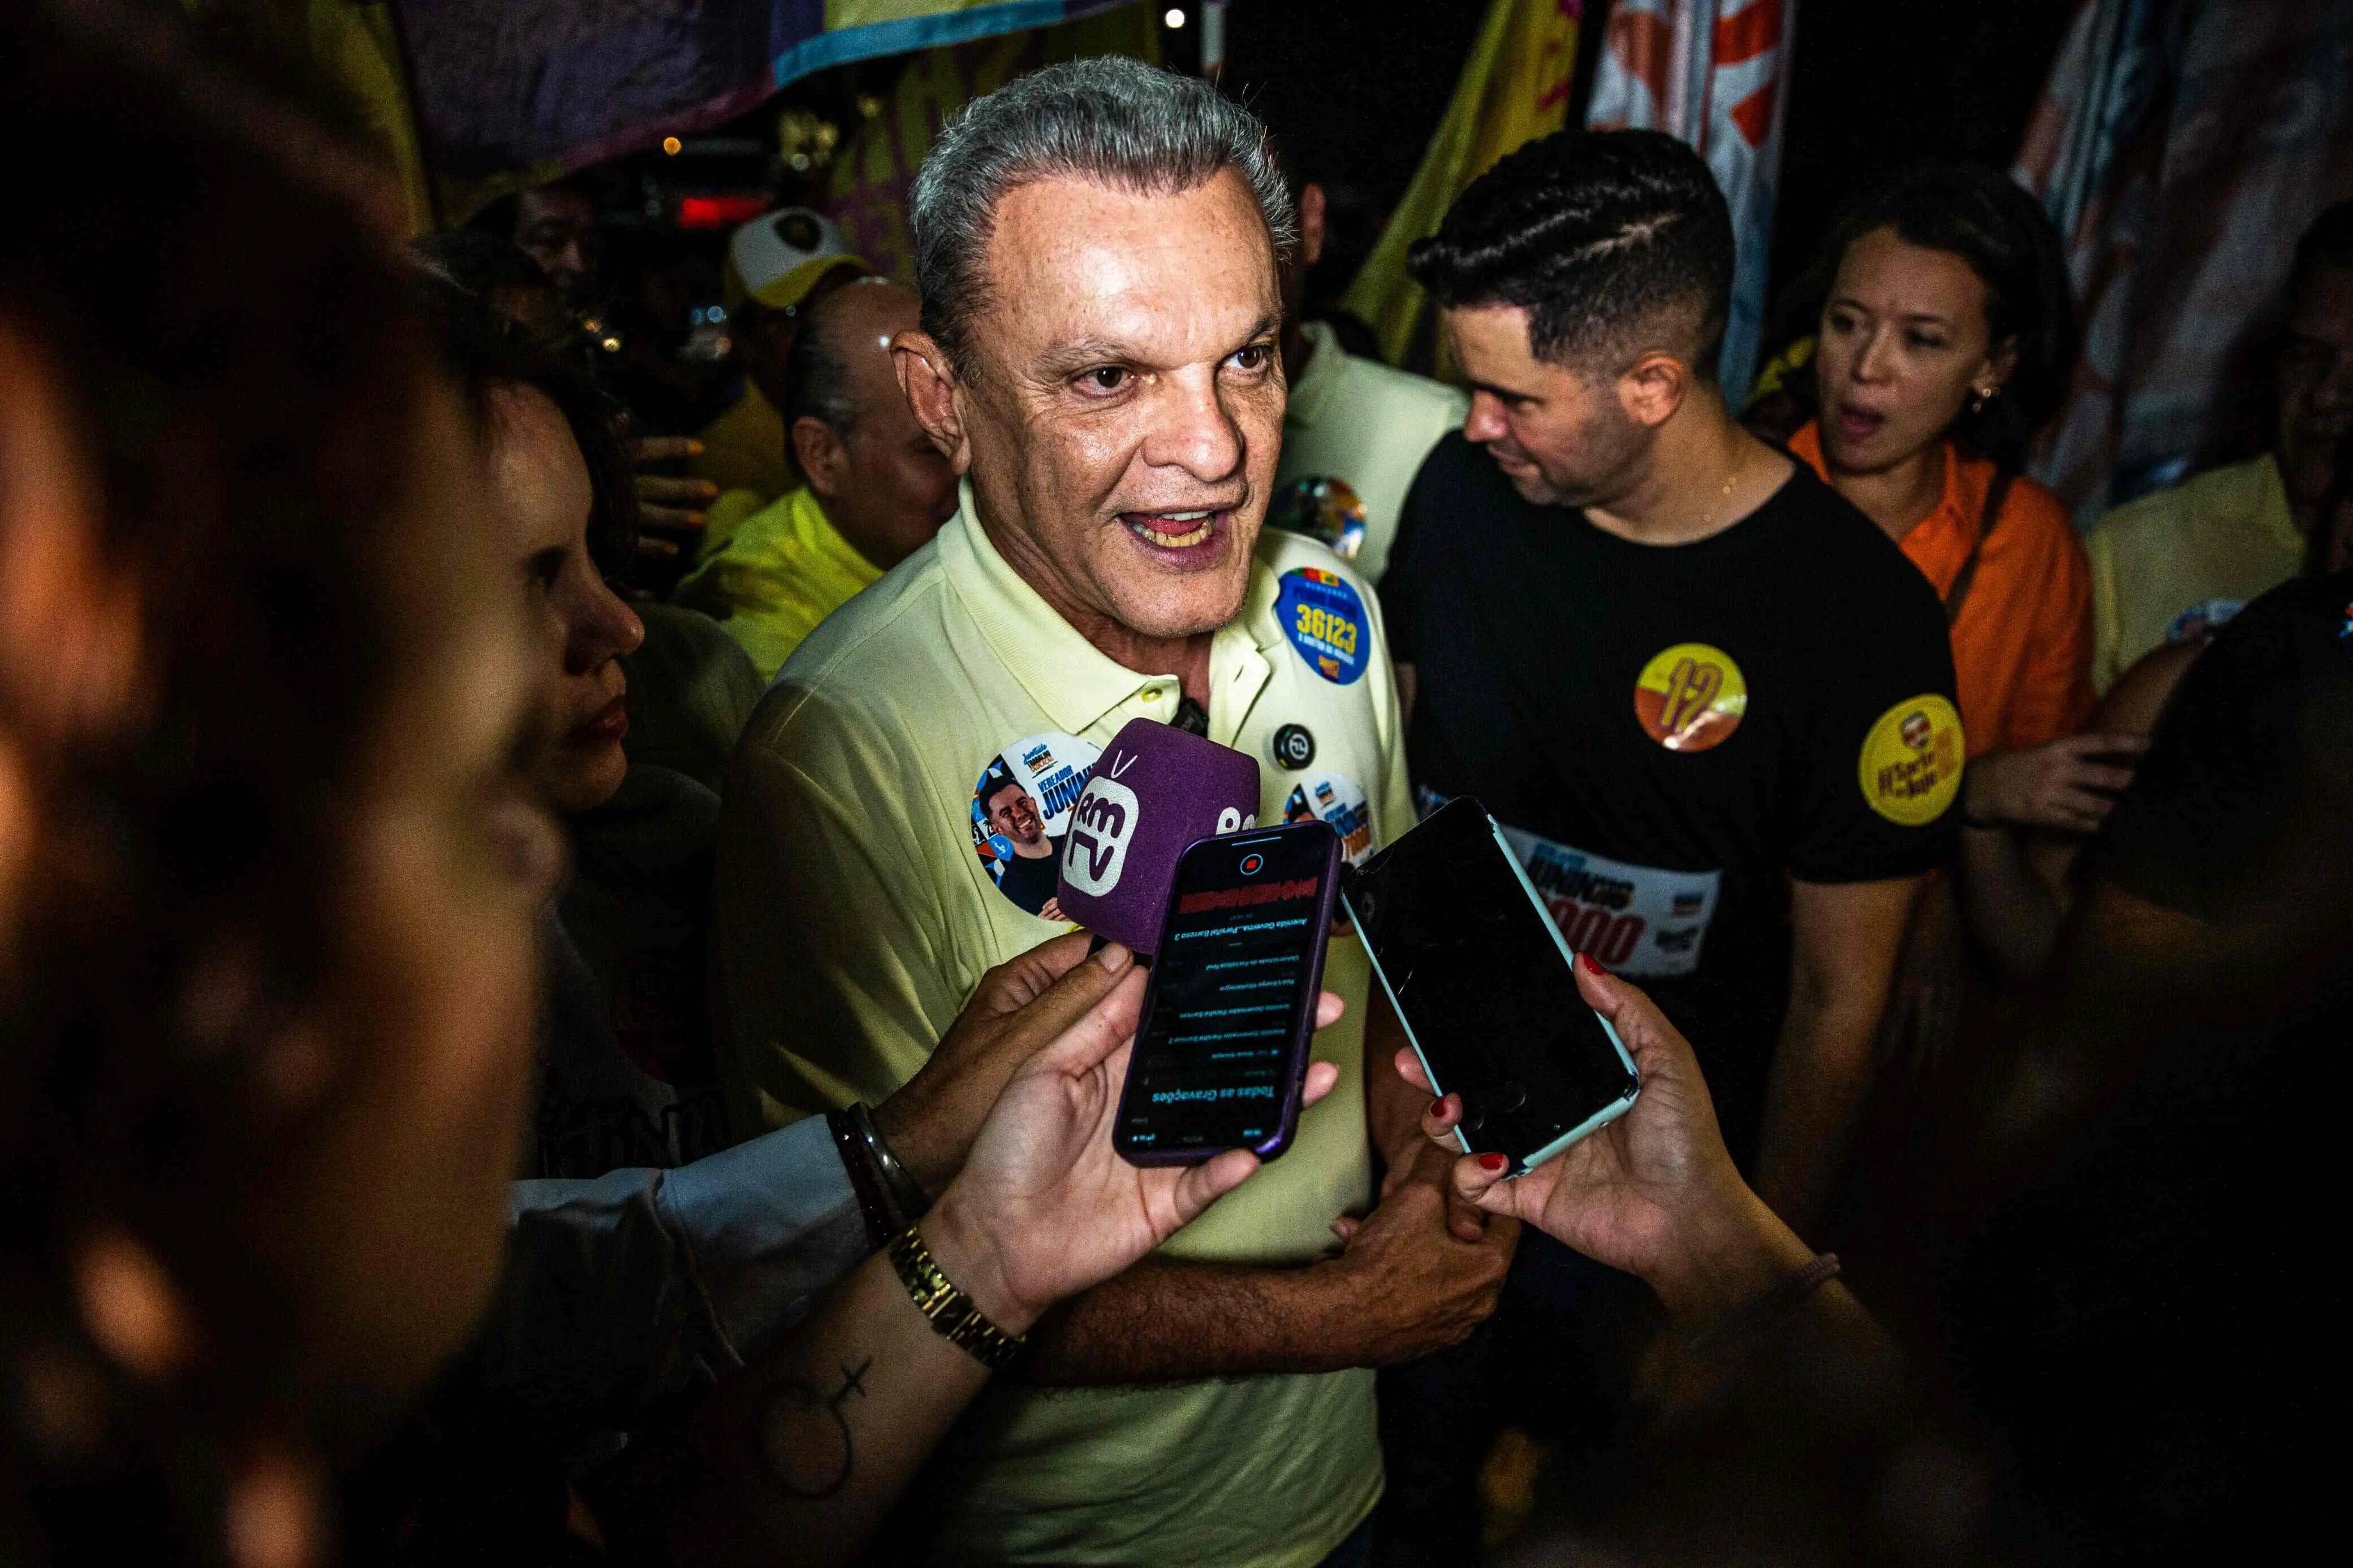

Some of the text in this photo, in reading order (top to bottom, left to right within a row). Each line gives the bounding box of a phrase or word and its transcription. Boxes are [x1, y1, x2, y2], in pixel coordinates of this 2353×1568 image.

[1296, 603, 1357, 655] 36123
[1037, 764, 1074, 793] VEREADOR
[1068, 830, 1114, 881] TV
[1219, 1087, 1236, 1099] as
[1237, 1085, 1274, 1099] Todas
